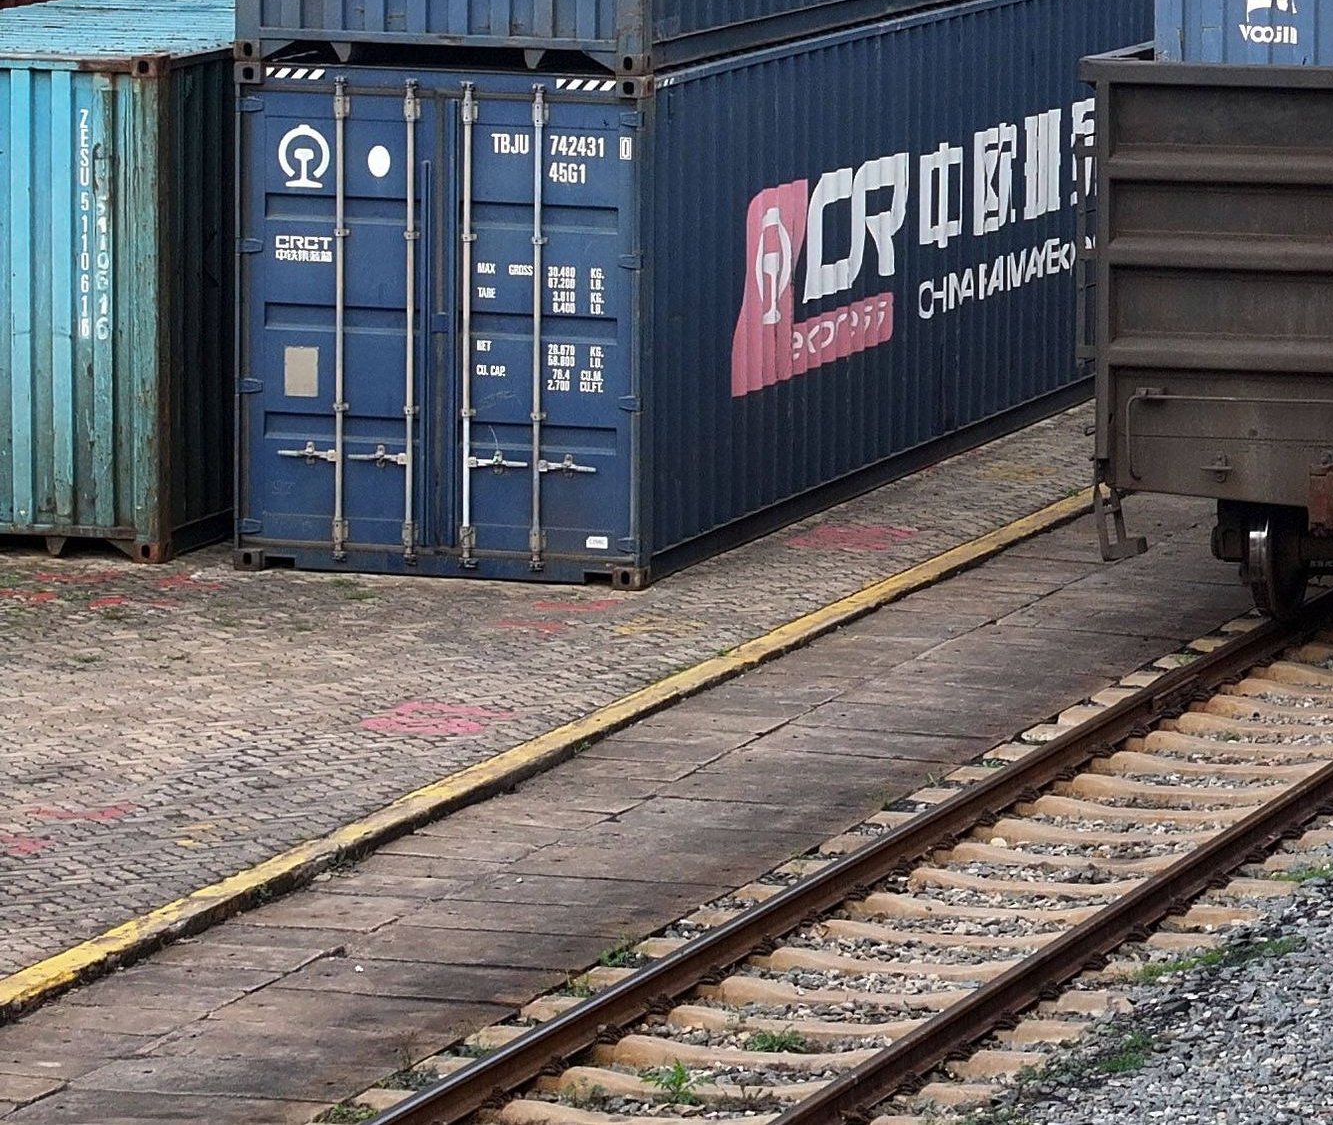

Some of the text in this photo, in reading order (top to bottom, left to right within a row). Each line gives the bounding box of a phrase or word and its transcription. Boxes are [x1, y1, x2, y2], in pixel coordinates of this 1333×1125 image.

[491, 133, 530, 155] TBJU
[549, 135, 605, 158] 742431
[549, 163, 586, 184] 45G1
[802, 152, 910, 304] CR
[275, 235, 333, 249] CRCT
[477, 263, 496, 274] MAX
[508, 265, 533, 276] GROSS
